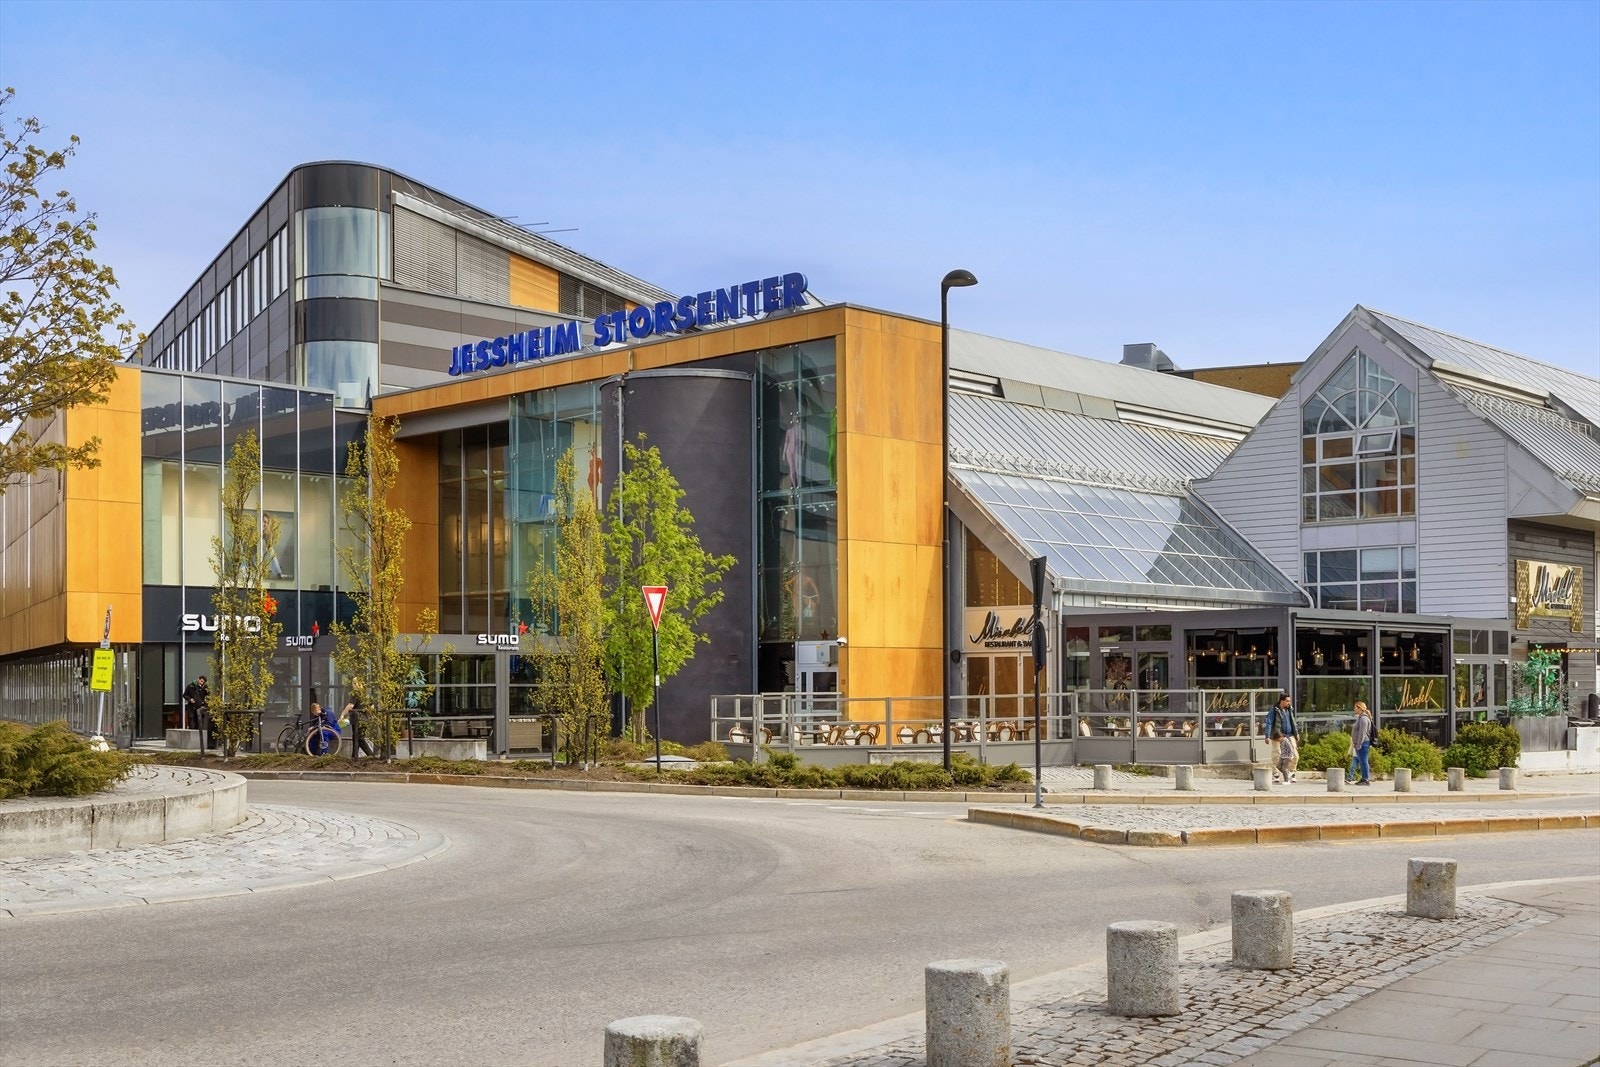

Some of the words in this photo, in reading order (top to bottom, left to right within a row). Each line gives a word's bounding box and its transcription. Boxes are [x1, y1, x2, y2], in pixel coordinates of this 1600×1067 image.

[448, 320, 582, 376] JESSHEIM
[593, 272, 808, 347] STORSENTER
[286, 635, 313, 646] SUMO
[477, 634, 519, 644] SUMO
